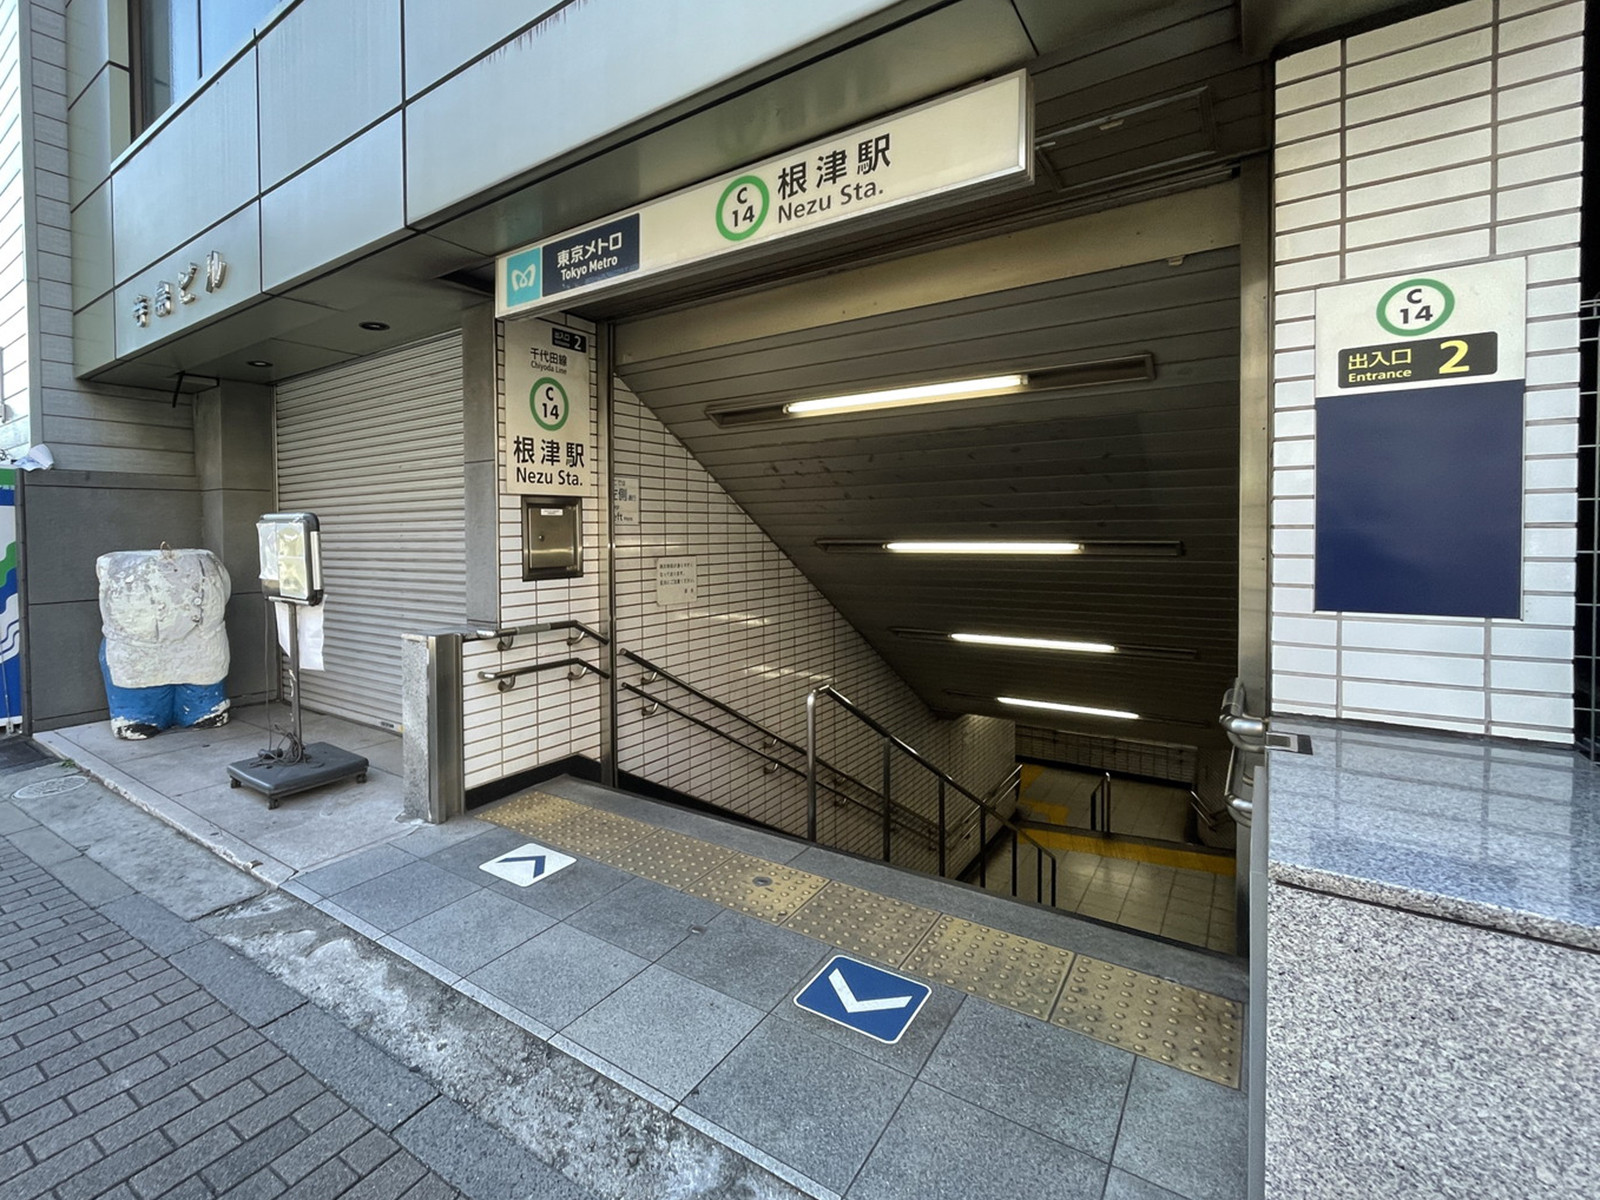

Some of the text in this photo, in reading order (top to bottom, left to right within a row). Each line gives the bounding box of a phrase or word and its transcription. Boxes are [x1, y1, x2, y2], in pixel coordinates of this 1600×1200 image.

[778, 133, 891, 200] 根津駅
[736, 187, 748, 205] C
[777, 181, 883, 224] Nezu Sta.
[731, 205, 755, 228] 14
[556, 232, 623, 268] 東京メトロ
[561, 254, 618, 282] Tokyo Metro
[1406, 288, 1423, 304] C
[1400, 305, 1434, 325] 14
[573, 335, 582, 350] 2
[530, 347, 568, 367] 千代田線
[1347, 340, 1470, 375] 出入口 2
[530, 360, 567, 375] Chiyoda Line
[1348, 367, 1412, 383] Entrance
[545, 386, 555, 402] C
[541, 402, 560, 420] 14
[513, 436, 585, 468] 根津駅
[516, 466, 583, 487] Nezu Sta.
